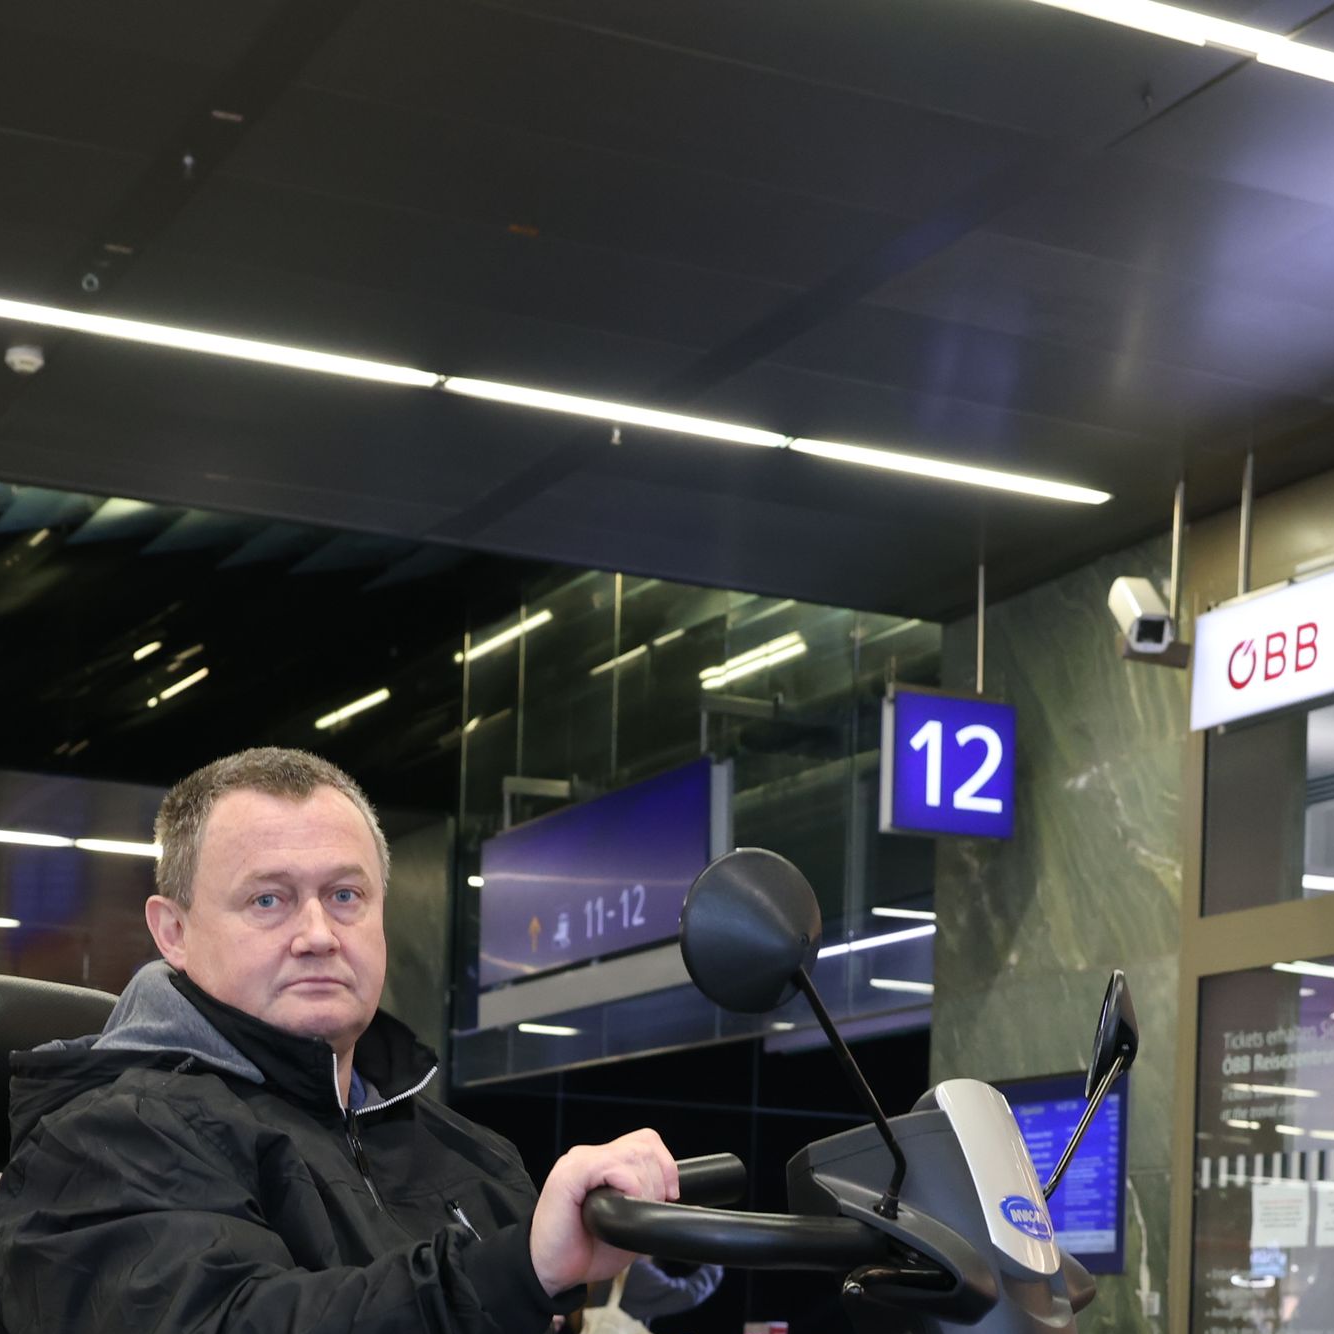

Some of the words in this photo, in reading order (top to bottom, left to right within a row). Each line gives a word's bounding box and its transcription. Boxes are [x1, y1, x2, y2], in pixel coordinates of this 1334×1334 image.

[1228, 621, 1319, 690] ÖBB
[909, 720, 1003, 814] 12
[584, 884, 646, 939] 11-12
